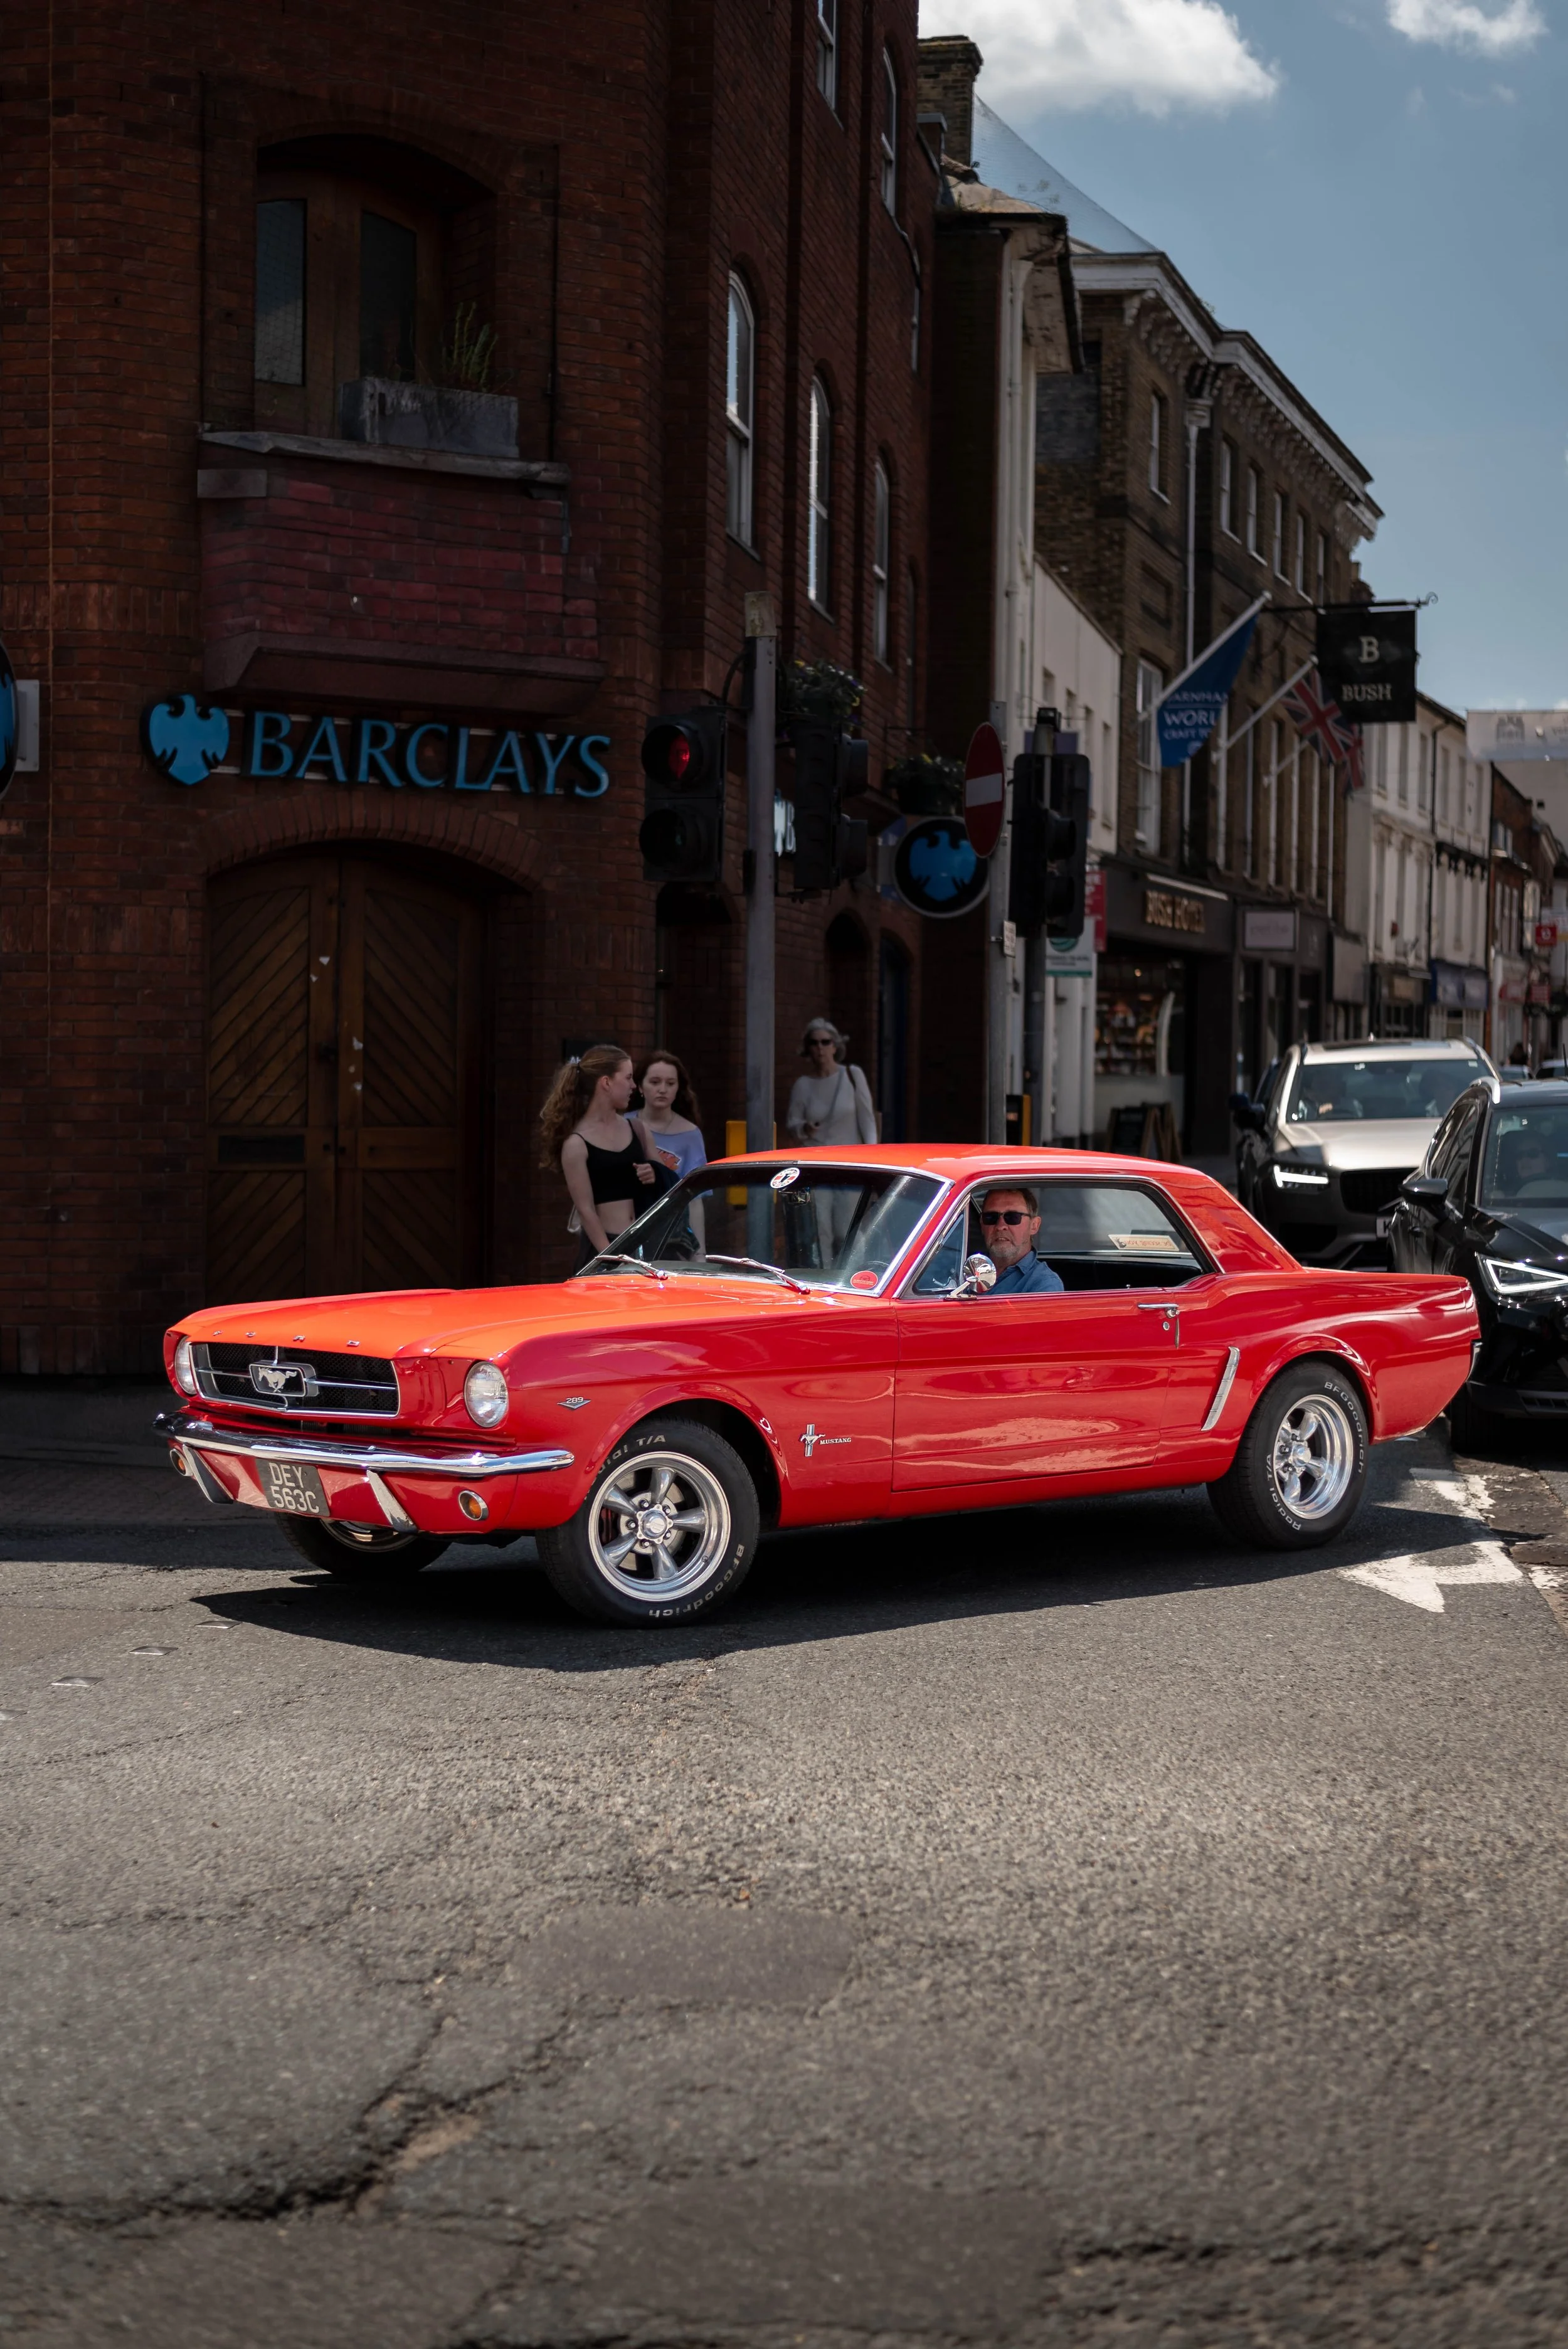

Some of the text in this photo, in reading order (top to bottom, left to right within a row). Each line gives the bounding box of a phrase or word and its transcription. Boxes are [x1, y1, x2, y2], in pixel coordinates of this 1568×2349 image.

[1358, 635, 1380, 664] B
[1341, 682, 1393, 702] BUSH
[250, 710, 611, 798] BARCLAYS
[635, 1434, 667, 1446] T/A
[819, 1437, 852, 1445] MUSTANG
[1324, 1381, 1365, 1473] BFGoodrich
[268, 1461, 304, 1488] DEY
[270, 1485, 320, 1514] 563C
[649, 1543, 745, 1618] BFGoodrich
